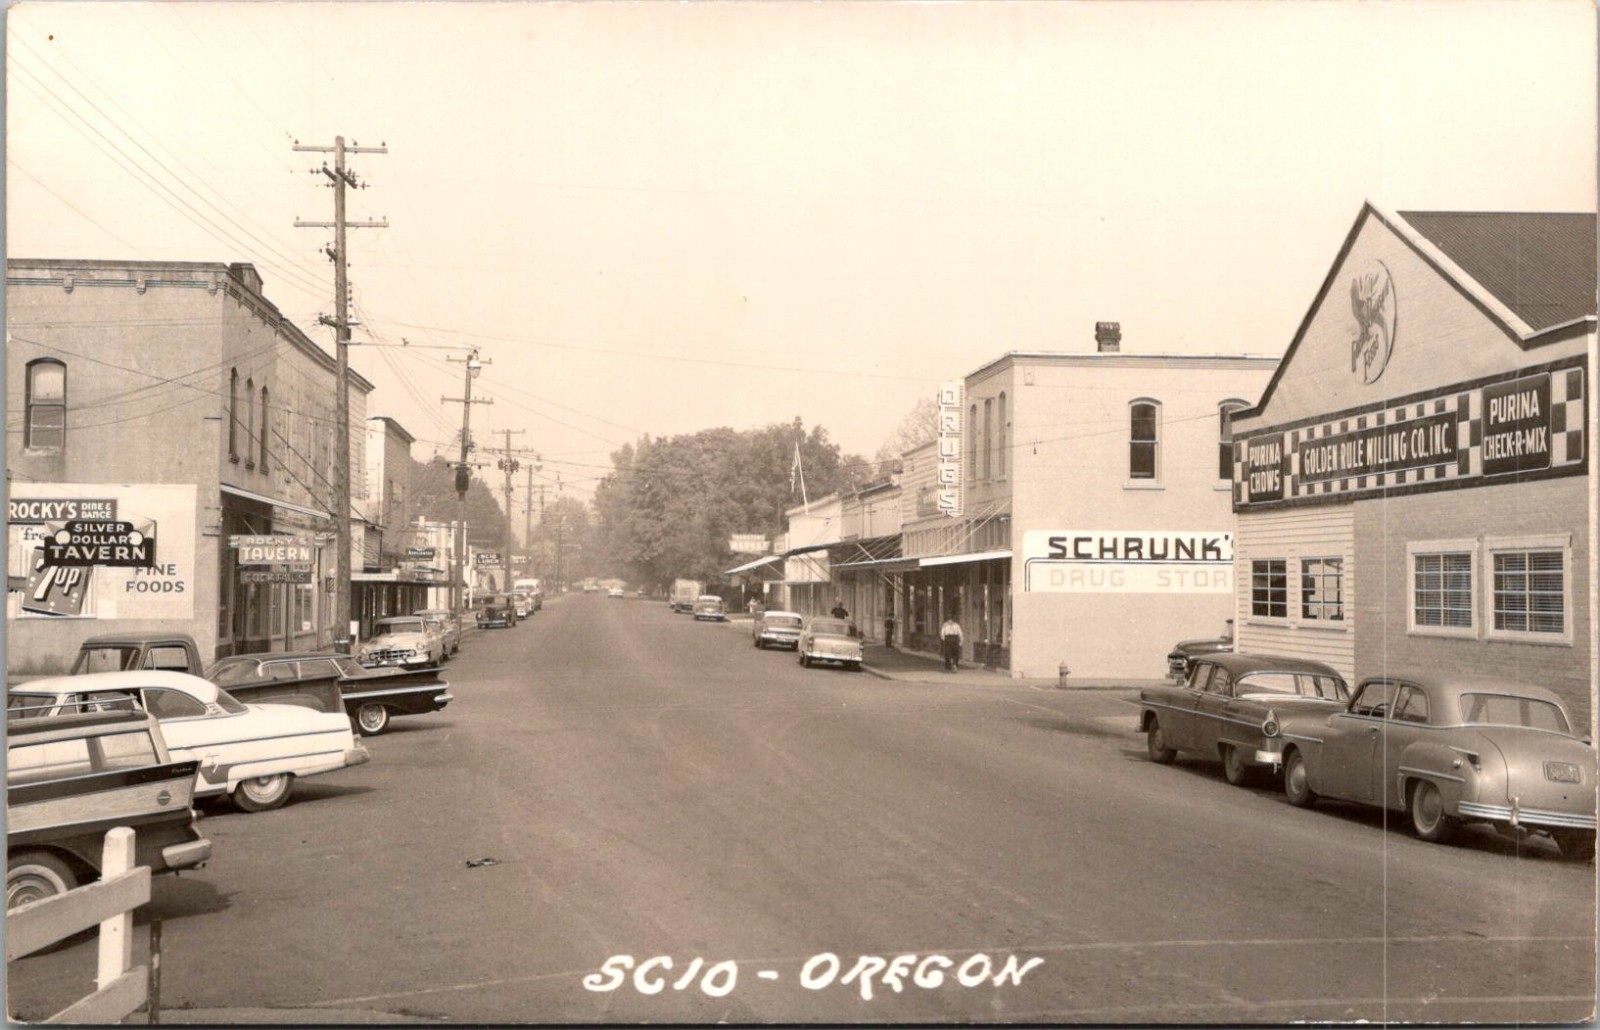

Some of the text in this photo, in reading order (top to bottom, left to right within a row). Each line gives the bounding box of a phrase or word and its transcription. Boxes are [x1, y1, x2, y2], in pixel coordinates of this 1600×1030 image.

[1489, 389, 1541, 425] PURINA
[940, 387, 957, 509] DRUGS
[1483, 426, 1548, 461] CHECK-R-MIX
[1248, 442, 1281, 469] PURINA
[1304, 443, 1338, 475] GOLDEN
[1341, 440, 1364, 470] RULE
[1366, 431, 1407, 466] MILLING
[1250, 469, 1281, 494] CHOWS
[10, 501, 77, 519] ROCKY'S
[81, 511, 111, 519] DANCE
[73, 523, 126, 533] SILVER
[72, 534, 128, 545] DOLLAR
[246, 537, 308, 545] ROCKY'S
[1048, 534, 1234, 560] SCHRUNK'
[49, 546, 146, 560] TAVERN
[241, 547, 310, 561] TAVERN
[135, 563, 177, 576] FINE
[1050, 569, 1125, 587] DRUG
[126, 581, 185, 593] FOODS
